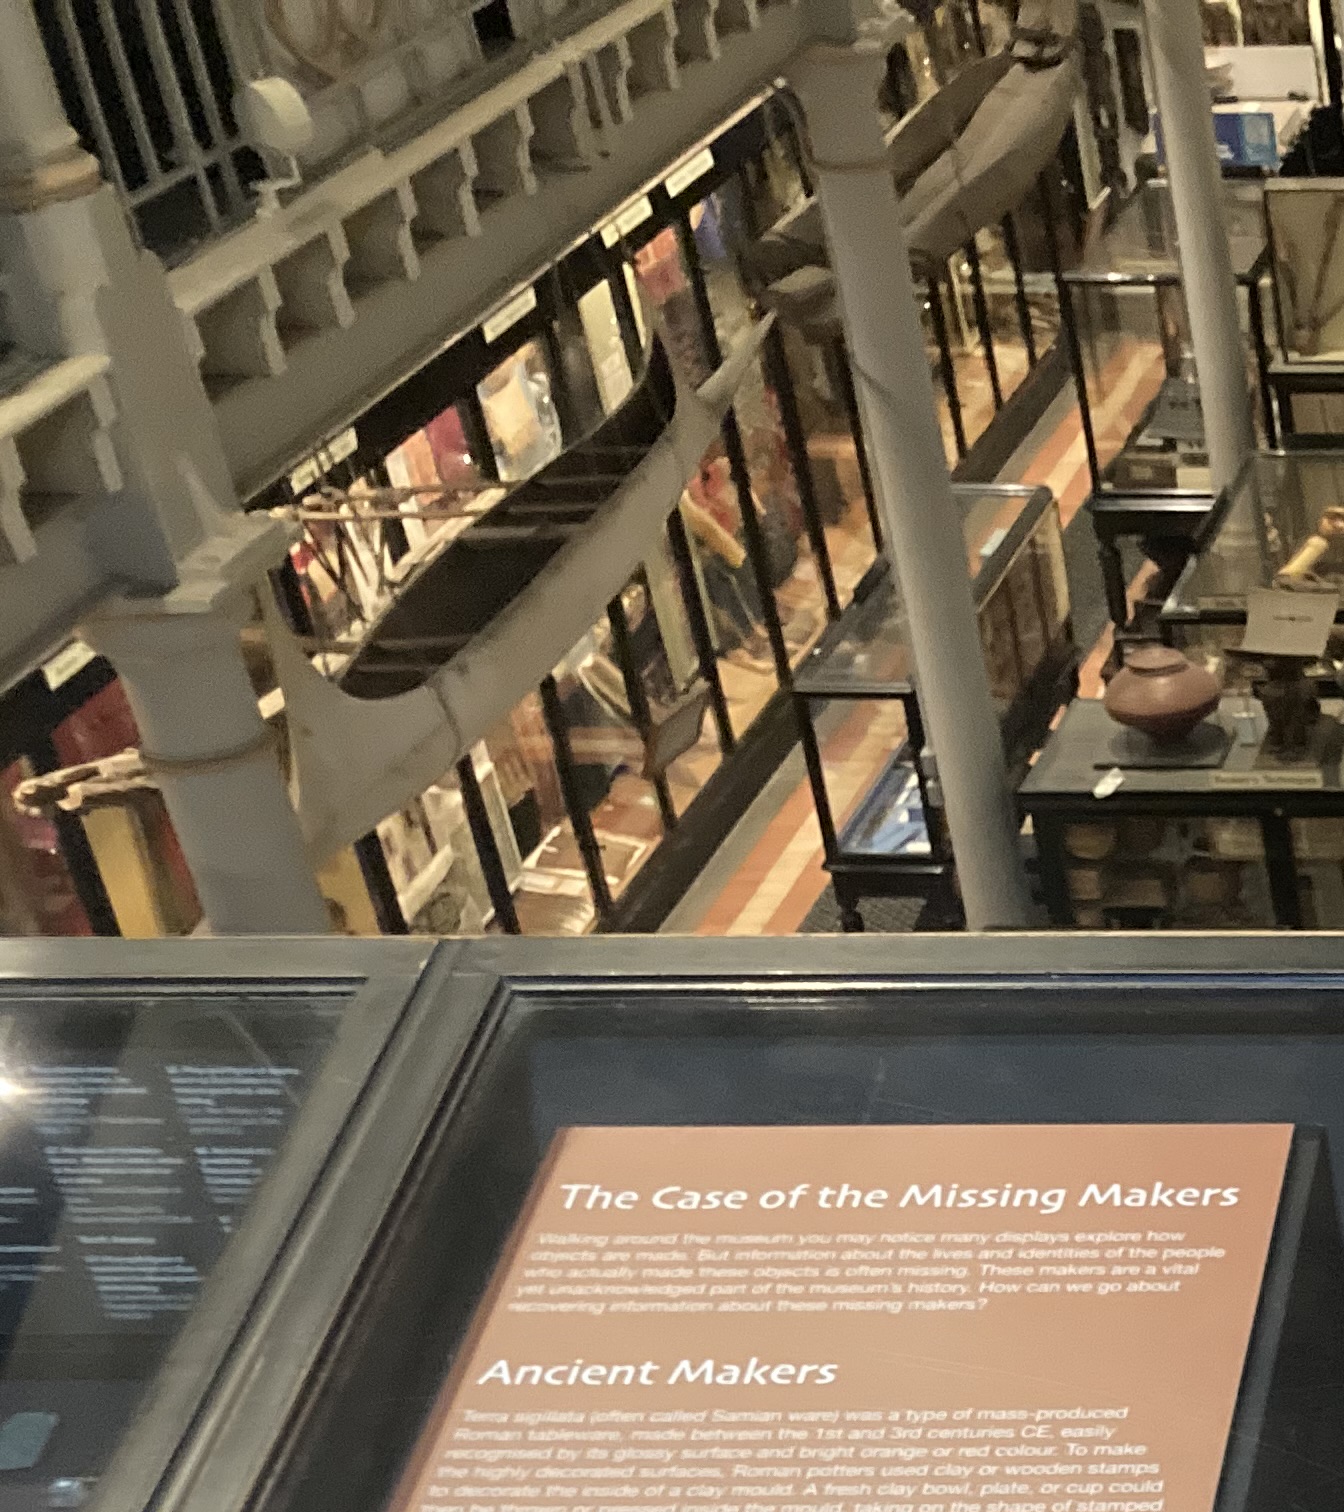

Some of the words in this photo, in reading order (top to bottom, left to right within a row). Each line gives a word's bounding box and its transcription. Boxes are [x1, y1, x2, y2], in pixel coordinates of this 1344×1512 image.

[564, 1183, 638, 1209] The
[652, 1186, 747, 1209] Case
[759, 1183, 809, 1208] of
[818, 1183, 887, 1207] the
[900, 1183, 1065, 1212] Missing
[1079, 1182, 1238, 1206] Makers
[478, 1359, 657, 1384] Ancient
[669, 1358, 836, 1384] Makers
